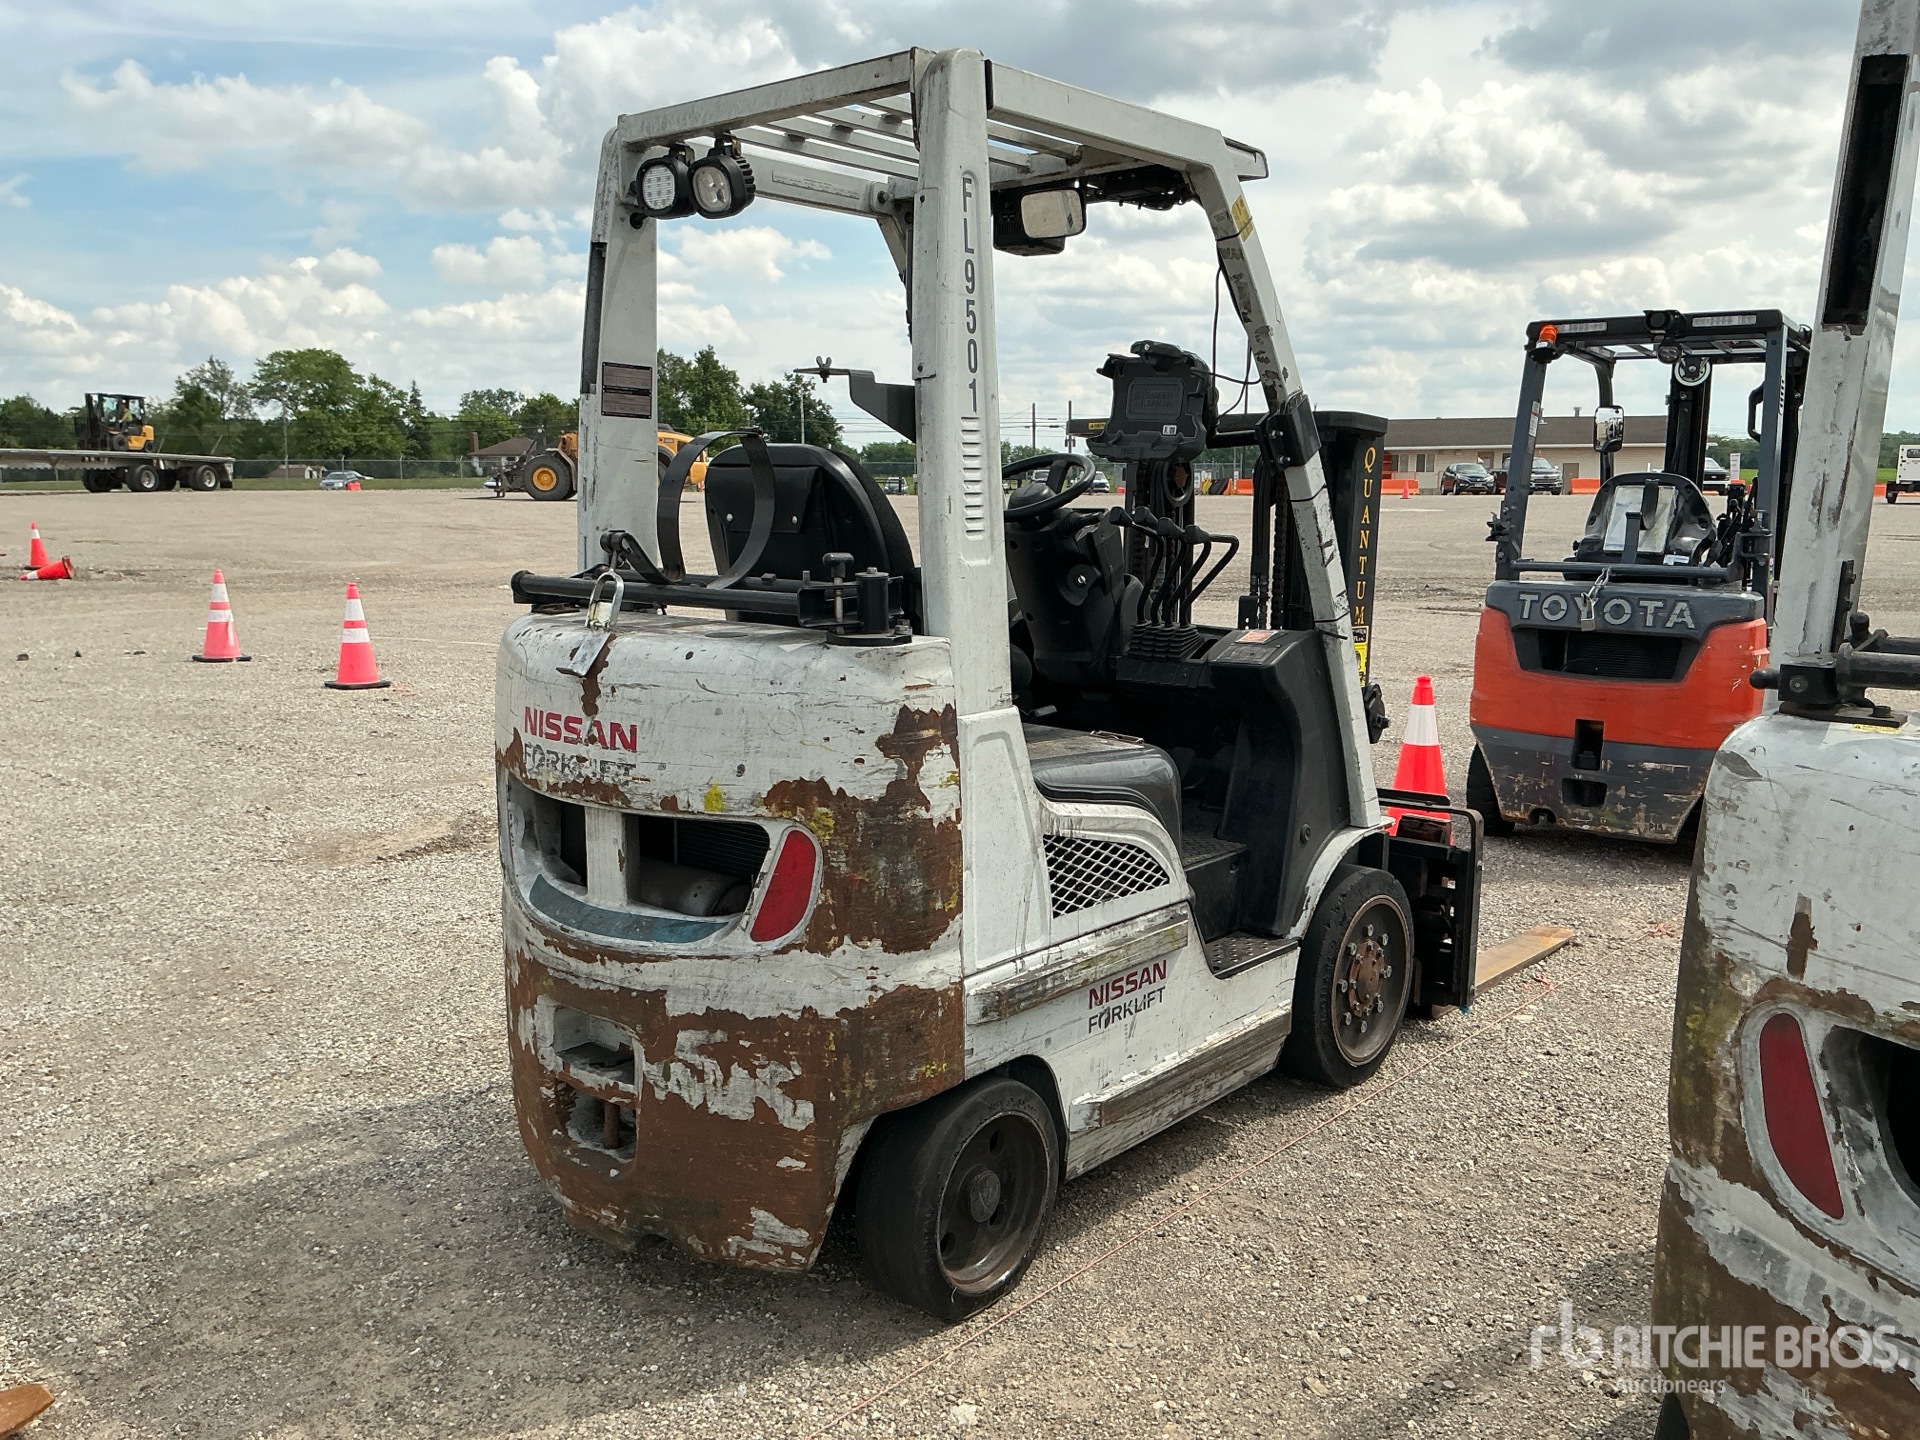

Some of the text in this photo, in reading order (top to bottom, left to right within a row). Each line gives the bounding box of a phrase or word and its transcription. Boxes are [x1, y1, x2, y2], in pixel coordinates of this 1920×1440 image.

[962, 177, 978, 413] FL9501
[1354, 446, 1376, 625] QUANTUM
[1519, 593, 1695, 629] TOYOTA
[524, 706, 638, 753] NISSAN
[524, 742, 637, 786] FORKIFT
[1088, 959, 1167, 1010] NISSAN
